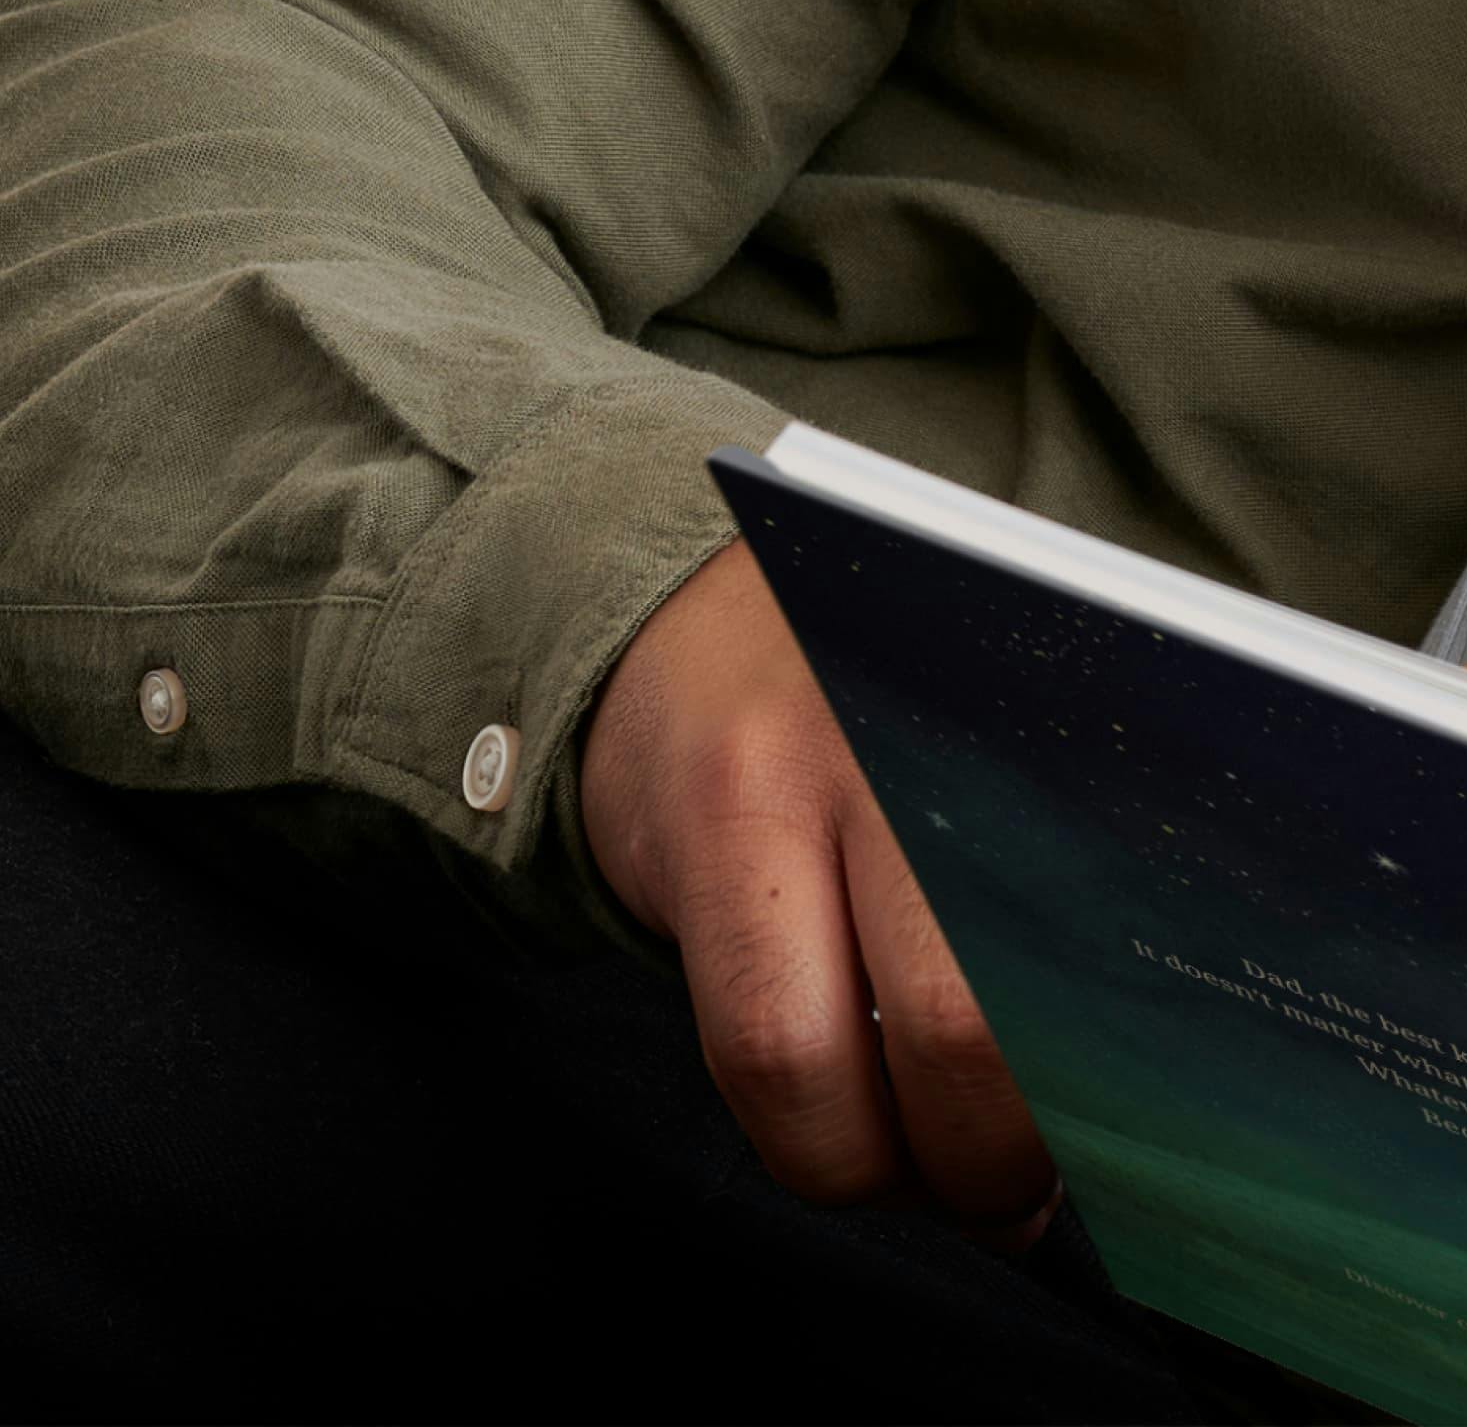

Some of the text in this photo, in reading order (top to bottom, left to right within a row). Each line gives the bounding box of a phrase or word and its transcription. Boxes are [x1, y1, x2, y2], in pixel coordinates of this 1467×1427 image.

[1130, 938, 1160, 963] It
[1164, 953, 1275, 1010] doesn't
[1281, 1003, 1384, 1055] matter
[1319, 991, 1371, 1025] the
[1376, 1011, 1443, 1054] best
